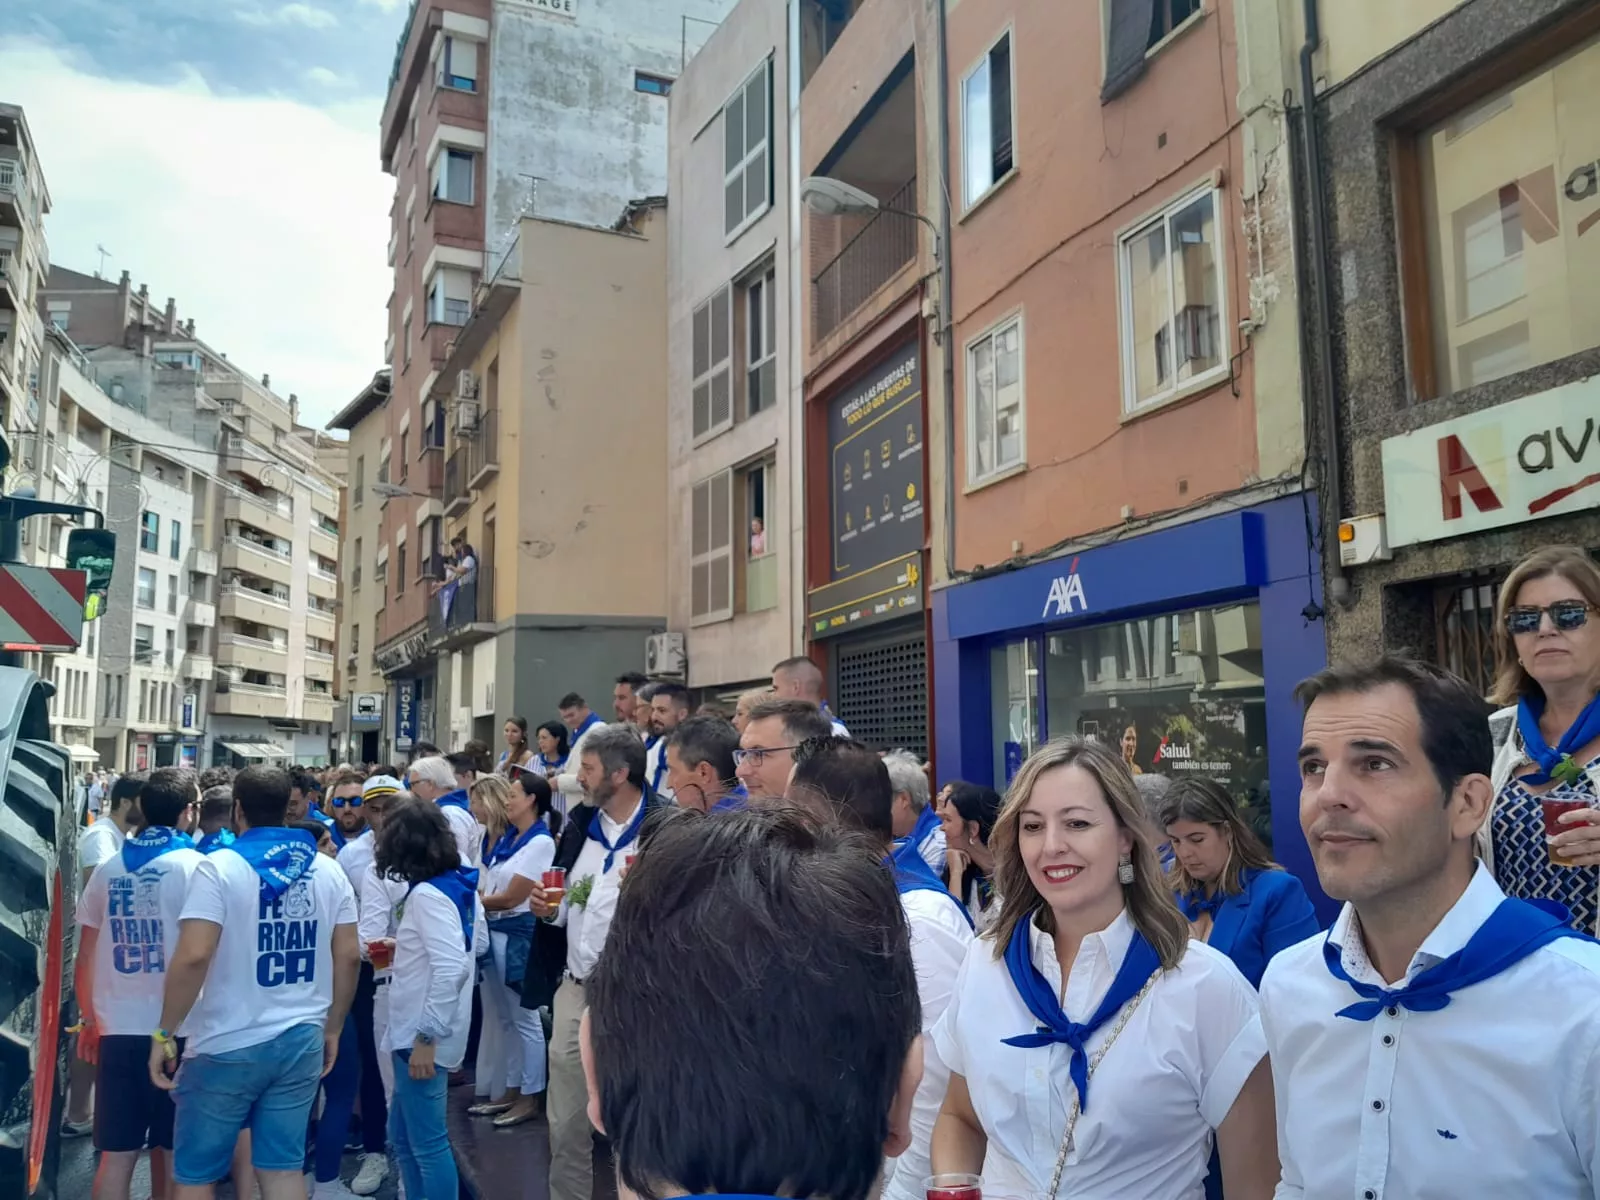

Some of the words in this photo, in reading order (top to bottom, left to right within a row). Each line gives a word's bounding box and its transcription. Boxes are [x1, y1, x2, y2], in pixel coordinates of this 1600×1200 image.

[1042, 570, 1087, 618] AXA
[401, 686, 411, 738] HOSTAL
[1160, 742, 1190, 758] Salud
[1172, 760, 1200, 770] también
[108, 889, 135, 917] FE
[110, 918, 164, 944] RRAN
[258, 920, 317, 952] RRAN
[113, 944, 165, 974] CA
[257, 949, 316, 988] CA
